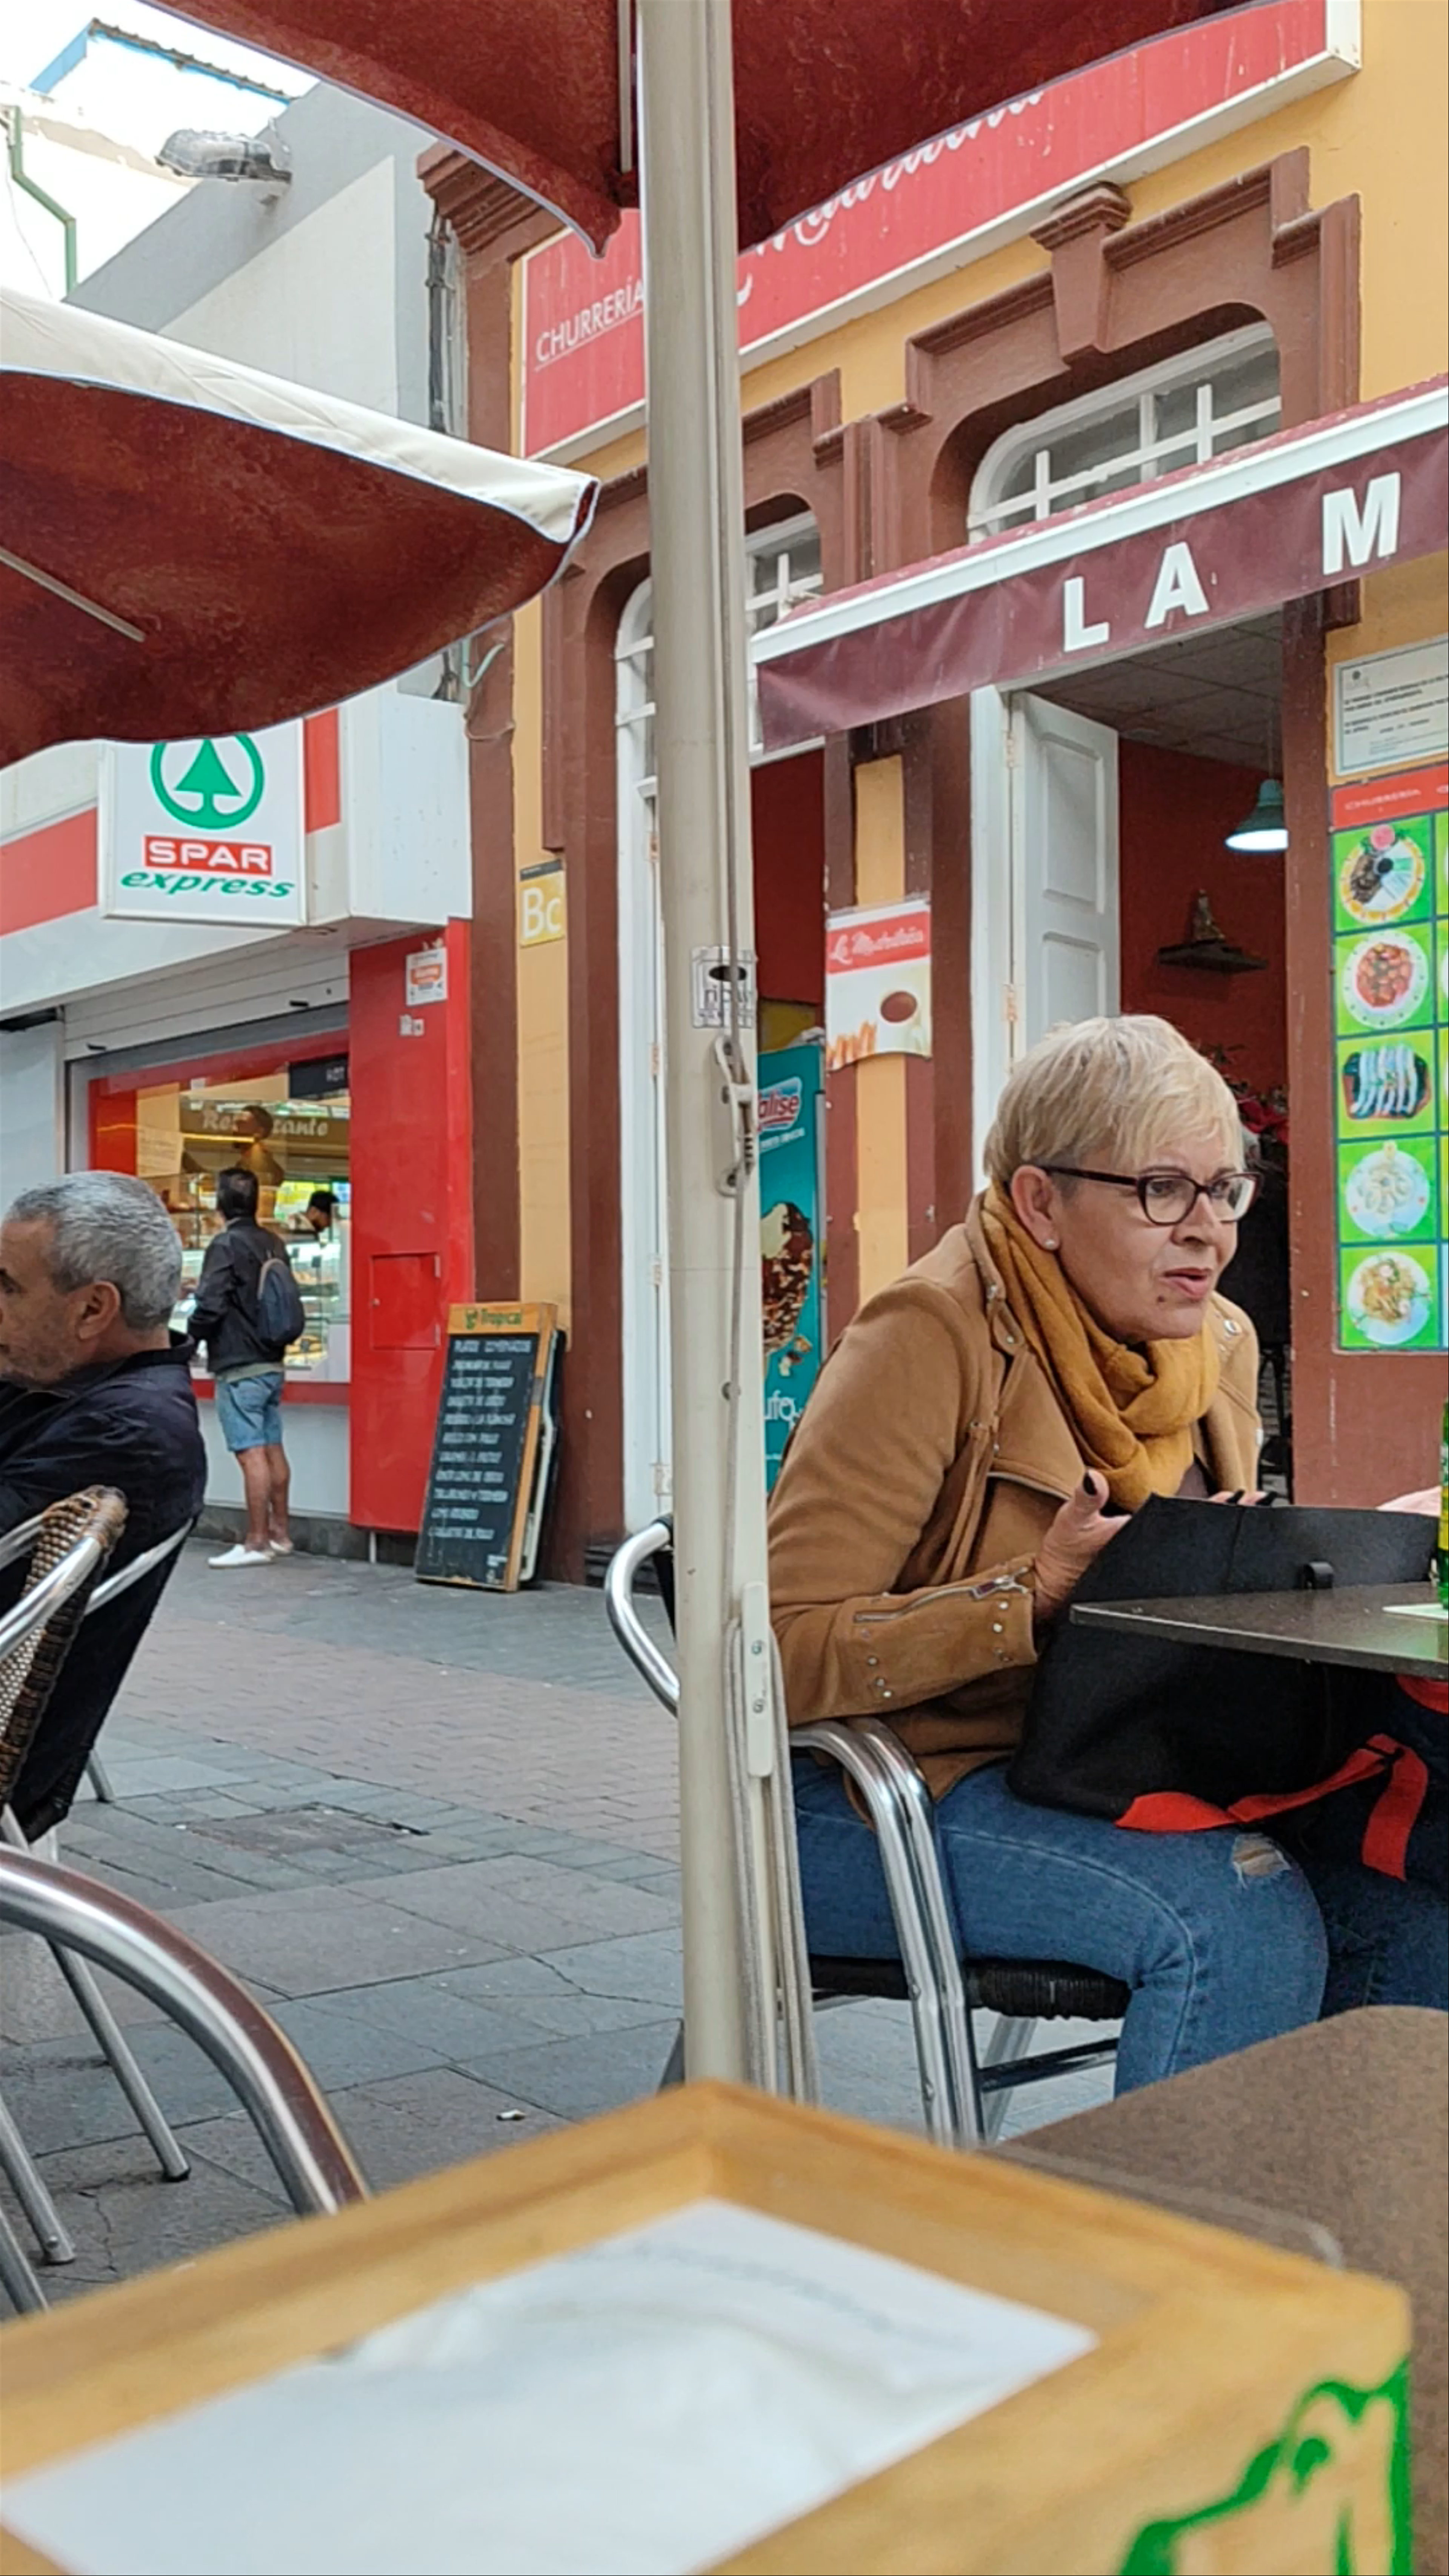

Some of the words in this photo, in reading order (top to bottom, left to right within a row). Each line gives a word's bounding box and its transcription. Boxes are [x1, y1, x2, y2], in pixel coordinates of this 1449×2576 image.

[1063, 541, 1210, 653] LA
[149, 841, 269, 871] SPAR
[120, 872, 295, 897] express
[758, 1087, 800, 1118] alise
